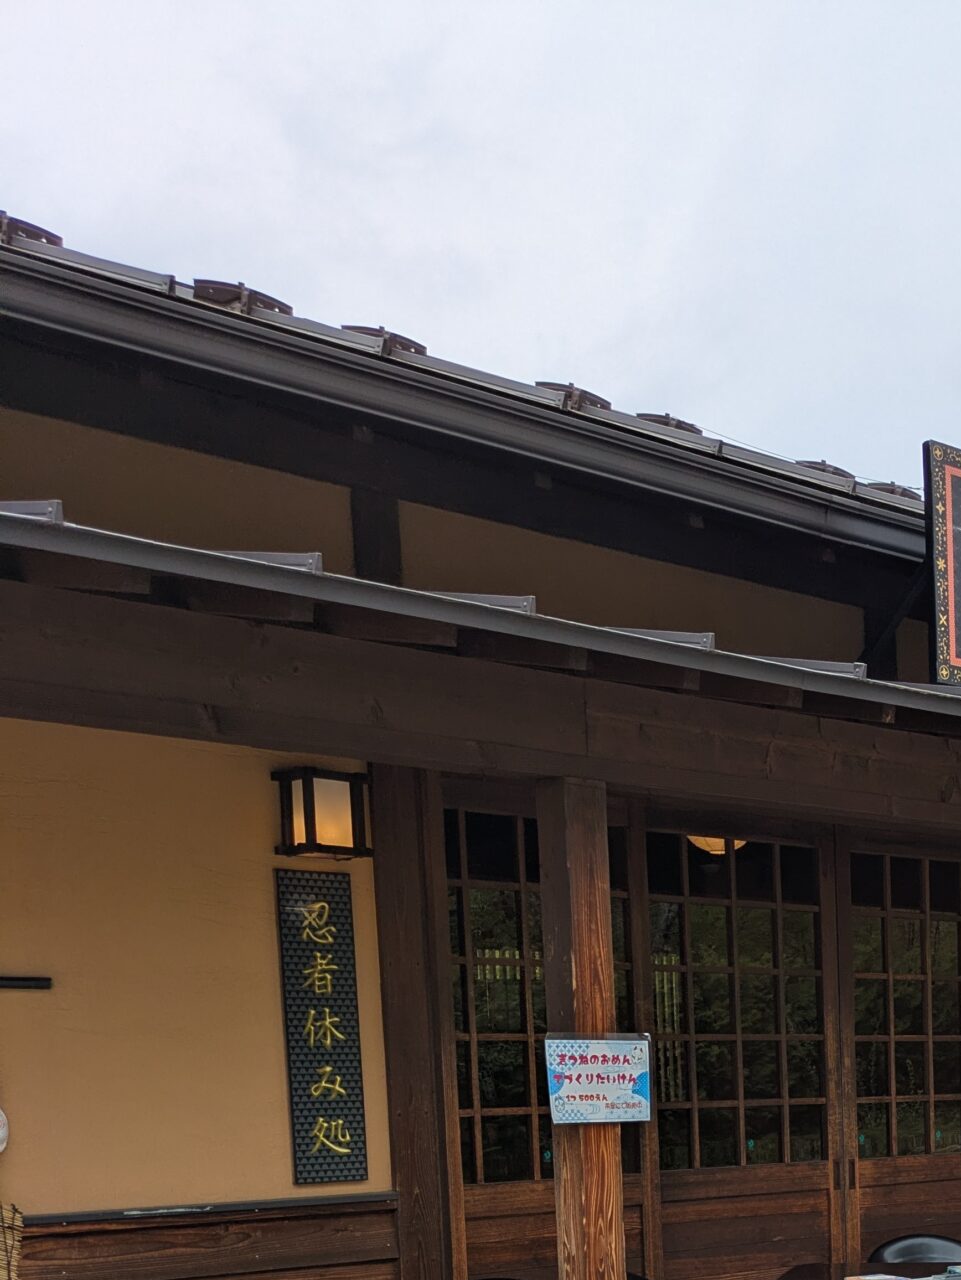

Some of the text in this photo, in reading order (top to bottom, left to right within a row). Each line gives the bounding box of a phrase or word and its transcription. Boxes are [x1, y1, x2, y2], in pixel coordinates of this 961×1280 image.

[301, 900, 352, 1155] 忍者休み処
[553, 1073, 637, 1085] てづくりたいけん
[579, 1094, 608, 1102] 500えん
